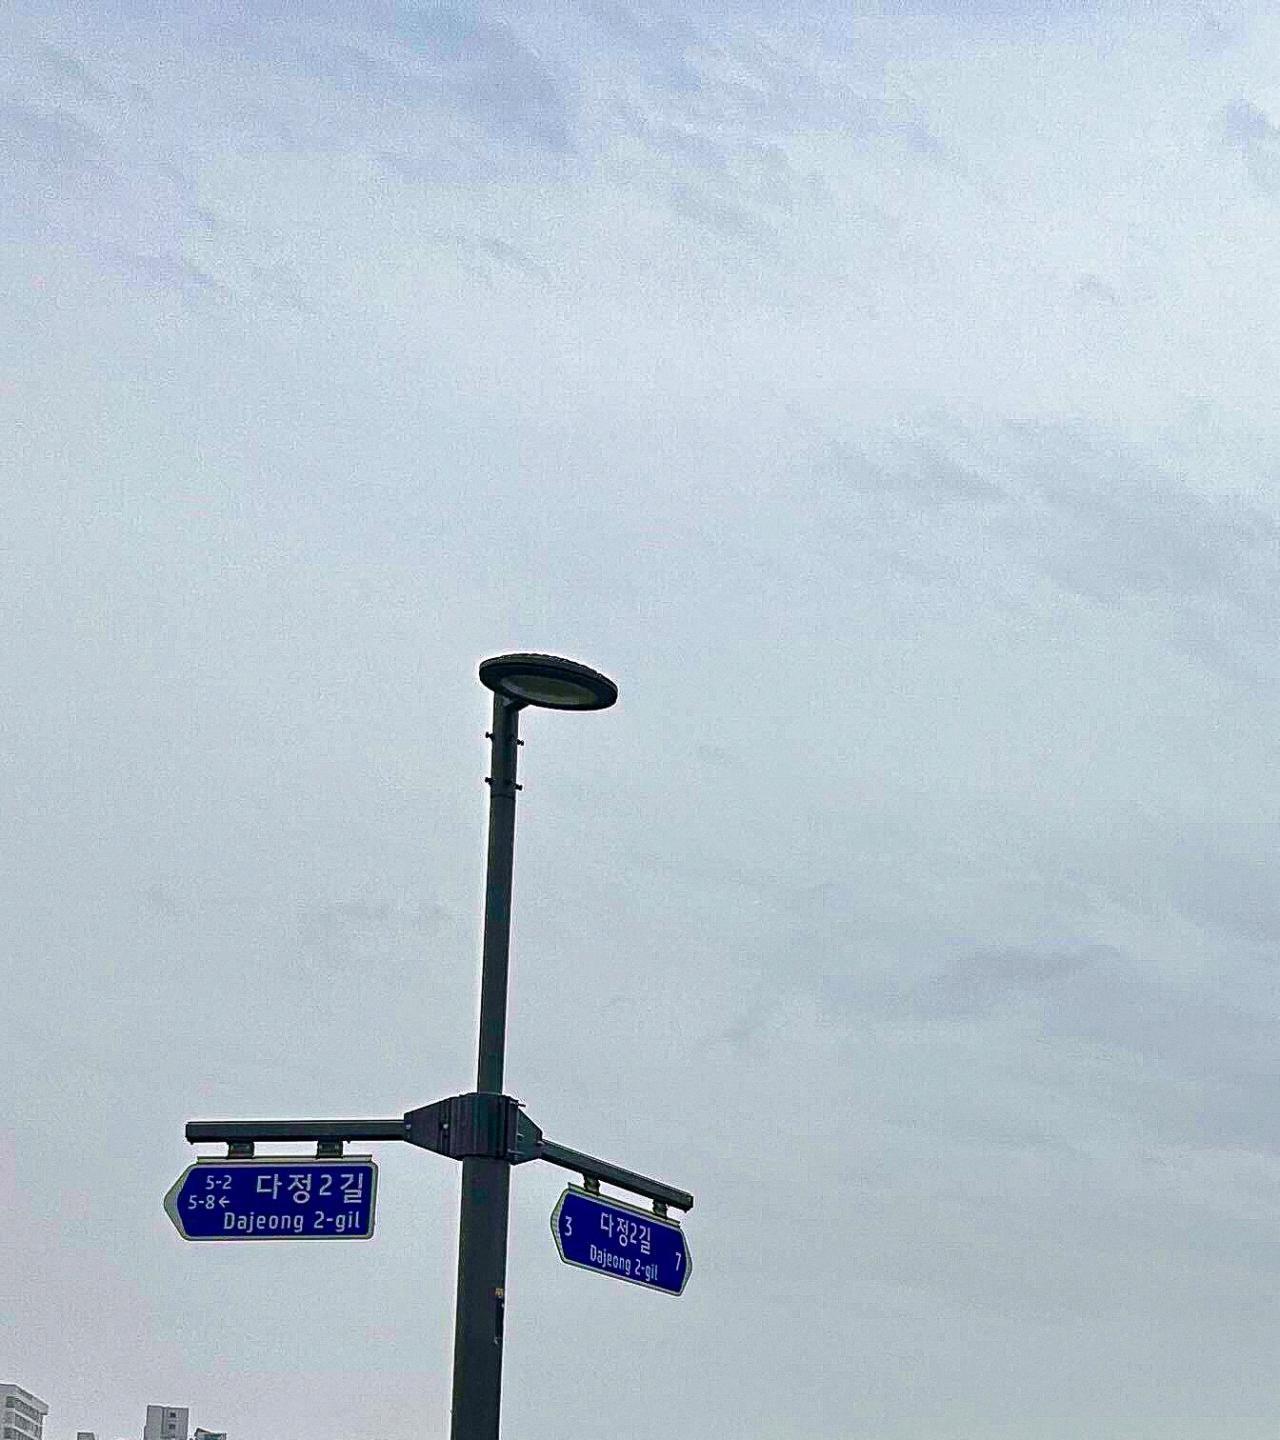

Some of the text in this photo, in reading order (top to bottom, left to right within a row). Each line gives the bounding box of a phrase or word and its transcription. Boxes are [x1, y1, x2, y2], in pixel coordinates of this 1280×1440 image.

[205, 1174, 233, 1190] 5-2
[256, 1172, 364, 1204] 다정2길
[187, 1194, 216, 1210] 5-8
[223, 1210, 361, 1233] Dajeong 2-gil
[563, 1215, 573, 1237] 3
[599, 1211, 652, 1255] 다정2길
[589, 1244, 659, 1281] Dajeong 2-gil
[674, 1251, 682, 1272] 7
